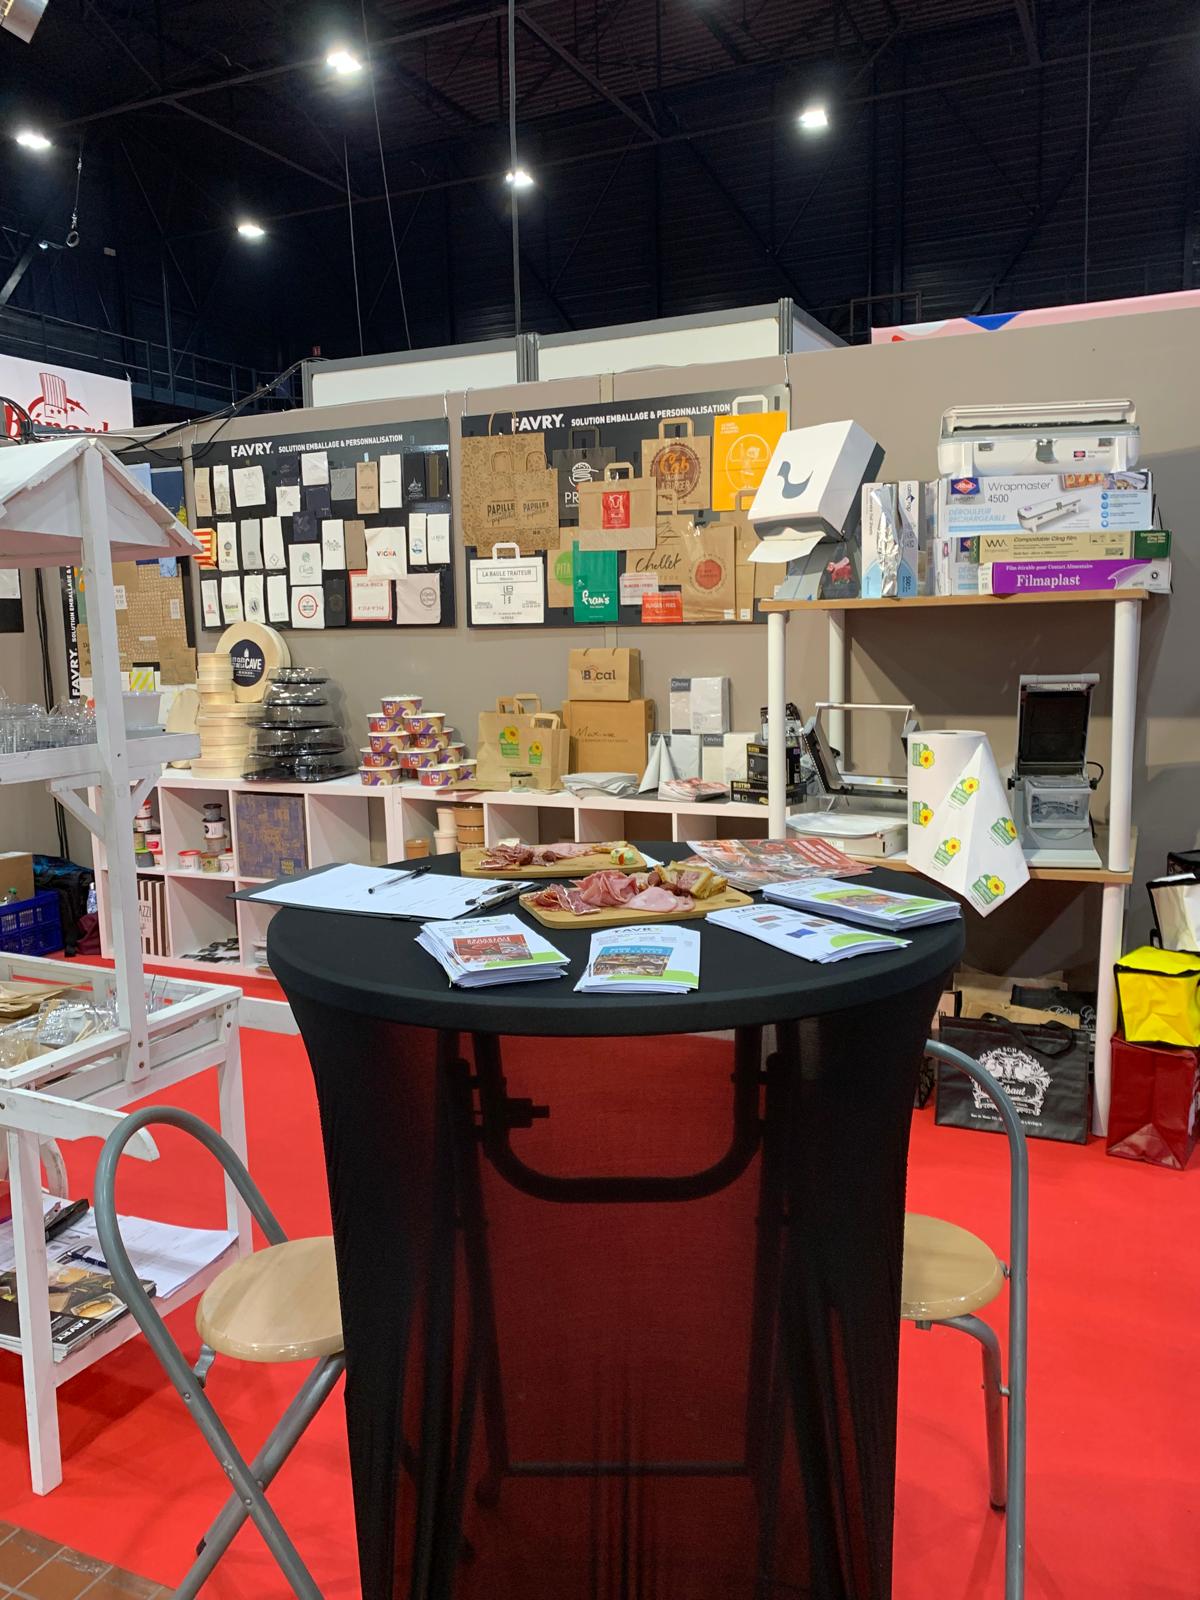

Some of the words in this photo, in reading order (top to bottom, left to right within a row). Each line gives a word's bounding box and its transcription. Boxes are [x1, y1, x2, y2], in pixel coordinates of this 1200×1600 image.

[571, 416, 605, 427] SOLUTION
[606, 411, 649, 424] EMBALLAGE
[650, 411, 655, 419] &
[656, 403, 731, 418] PERSONNALISATION
[278, 445, 305, 454] SOLUTION
[306, 441, 339, 451] EMBALLAGE
[345, 434, 403, 447] PERSONNALISATION
[988, 481, 1050, 492] Wrapmaster
[988, 493, 1009, 503] 4500
[1016, 573, 1081, 588] Filmaplast
[67, 575, 75, 611] EMBALLAGE
[244, 657, 262, 670] CAVE
